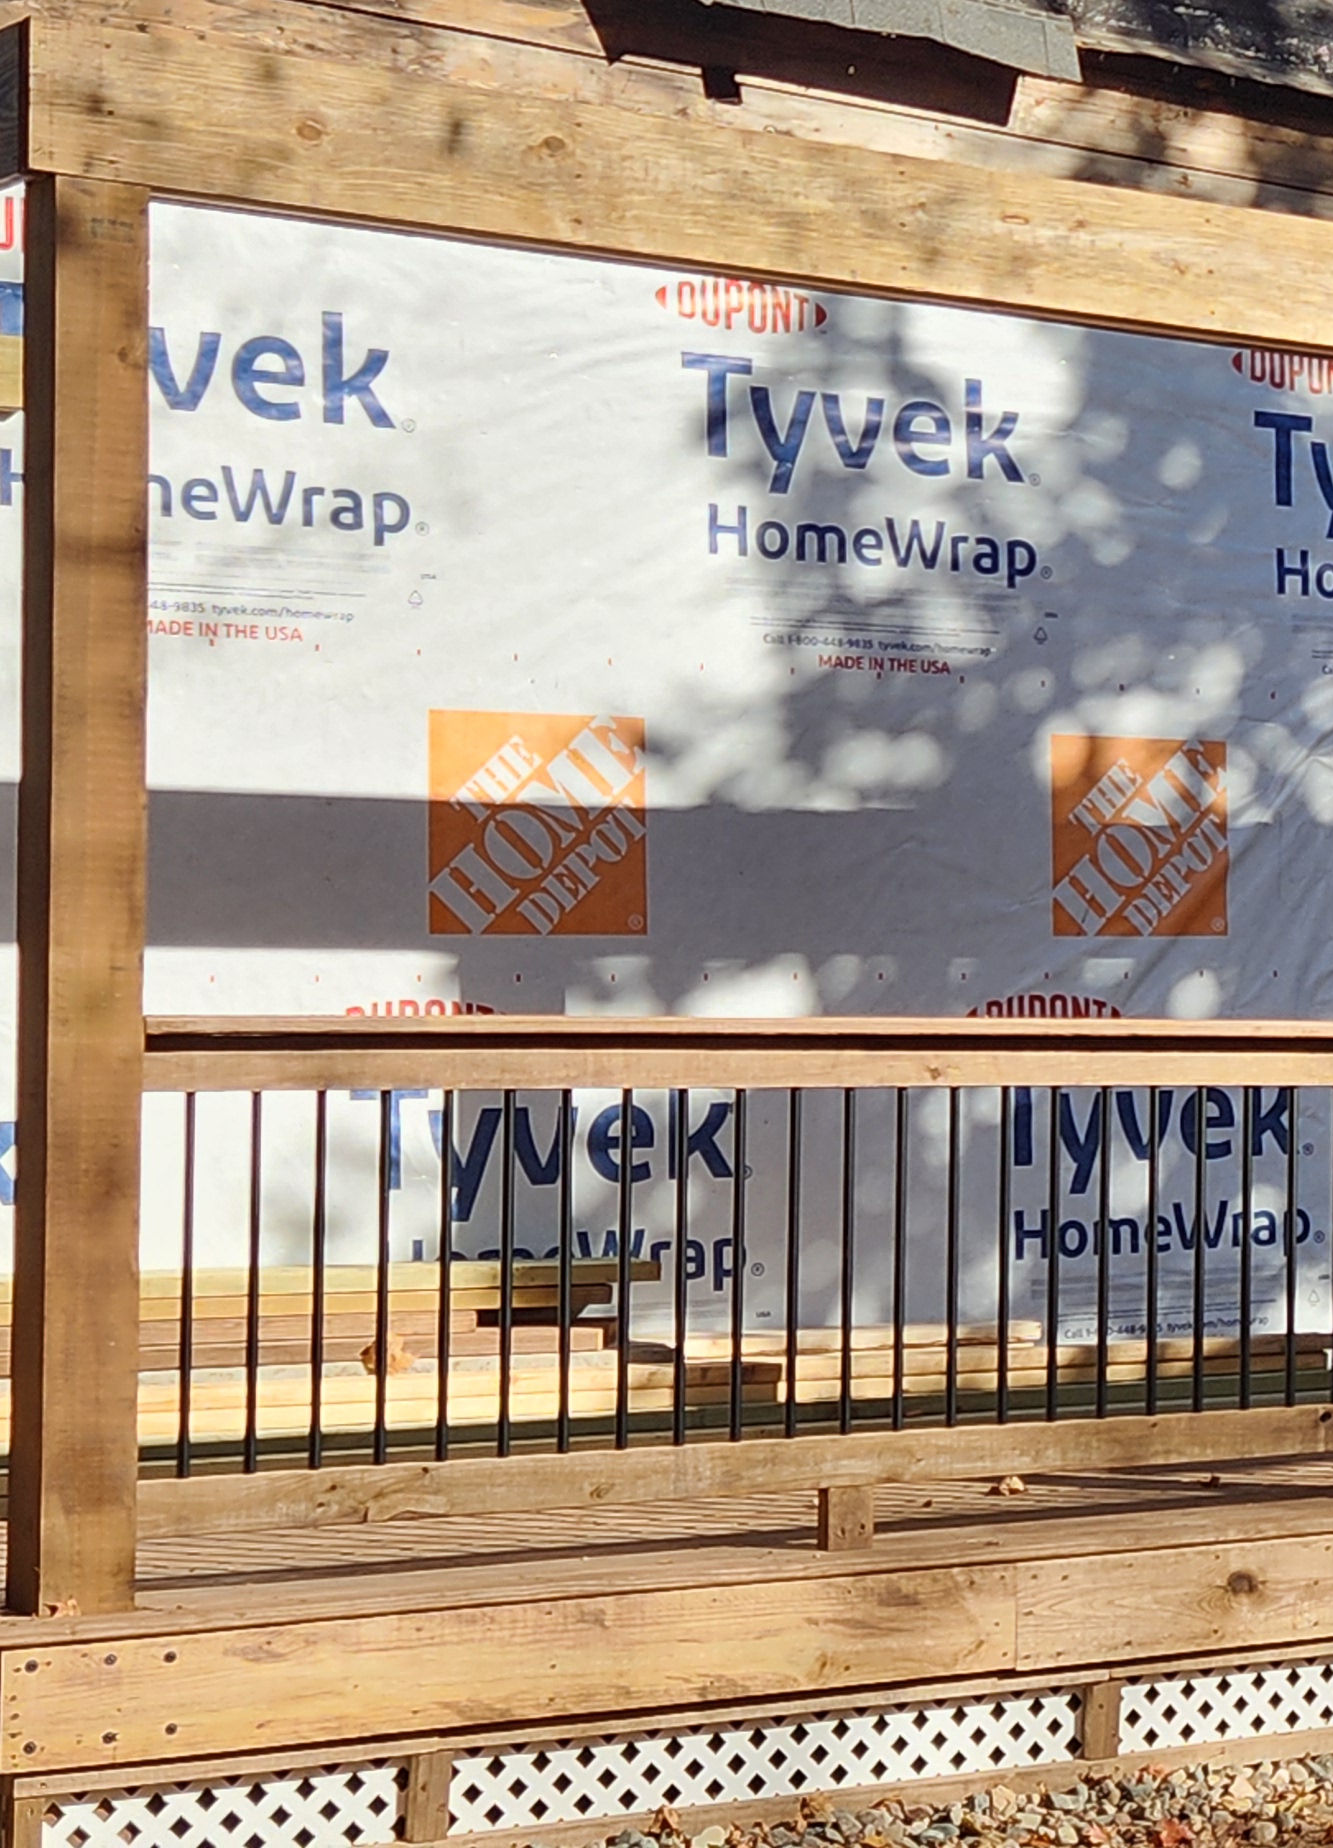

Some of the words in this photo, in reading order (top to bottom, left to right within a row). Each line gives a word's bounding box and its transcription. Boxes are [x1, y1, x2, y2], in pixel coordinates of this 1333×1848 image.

[678, 277, 810, 334] DUPONT
[148, 311, 396, 429] vek
[681, 351, 1026, 494] Tyvek
[708, 503, 1037, 589] HomeWrap
[199, 622, 218, 638] IN
[223, 624, 259, 640] THE
[265, 626, 303, 642] USA
[818, 654, 864, 670] MADE
[868, 656, 885, 671] IN
[888, 657, 917, 673] THE
[921, 659, 950, 675] USA
[450, 735, 543, 823] THE
[1068, 757, 1144, 837] THE
[428, 715, 647, 935] HOME
[516, 796, 647, 935] DEPOT
[1052, 739, 1227, 936] HOME
[1122, 813, 1228, 936] DEPOT
[1013, 1200, 1311, 1260] HomeWrap
